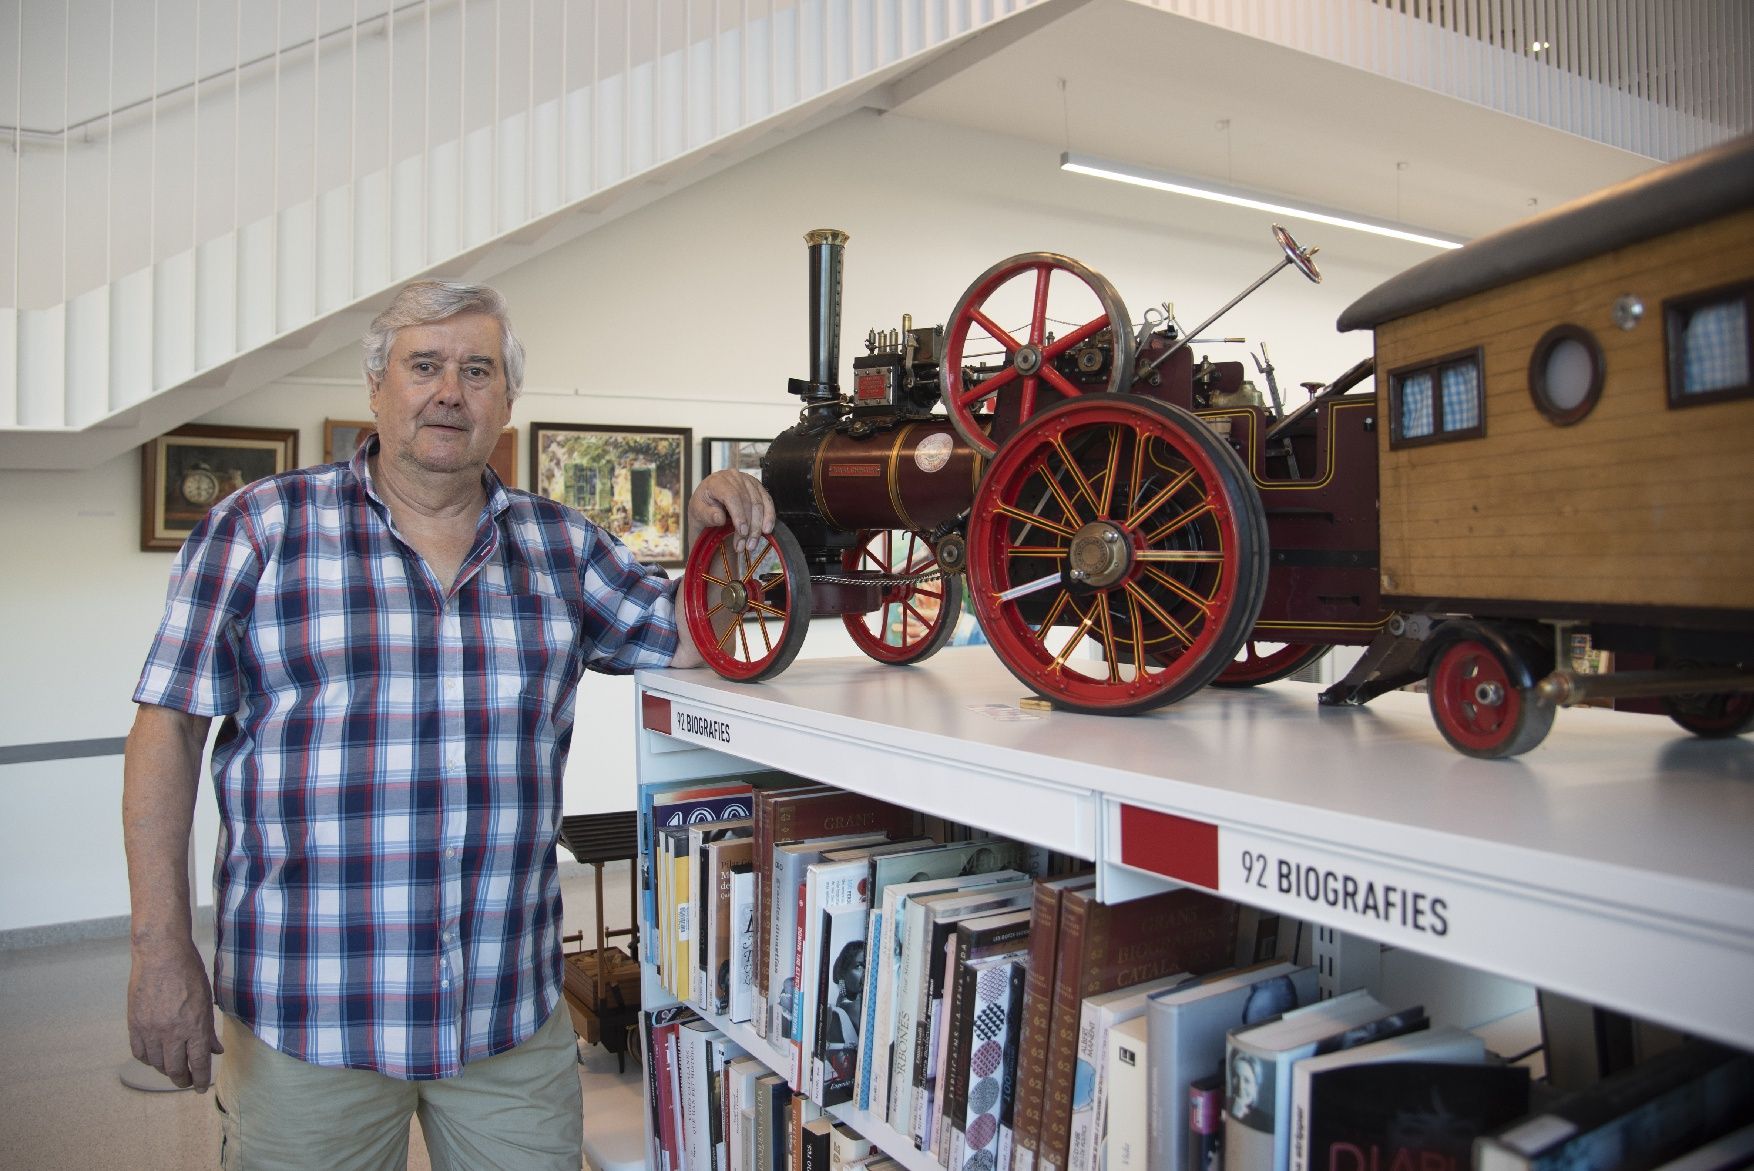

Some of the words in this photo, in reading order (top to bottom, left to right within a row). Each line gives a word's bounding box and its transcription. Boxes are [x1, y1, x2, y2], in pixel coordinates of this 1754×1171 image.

[677, 711, 686, 731] 92
[686, 713, 731, 744] BIOGRAFIES
[1241, 849, 1270, 890] 92
[1276, 858, 1450, 937] BIOGRAFIES
[1087, 1022, 1096, 1058] MANENT
[1057, 1060, 1071, 1072] 62
[1002, 1075, 1011, 1102] 100
[1054, 1091, 1068, 1102] 62
[1051, 1123, 1064, 1134] 62
